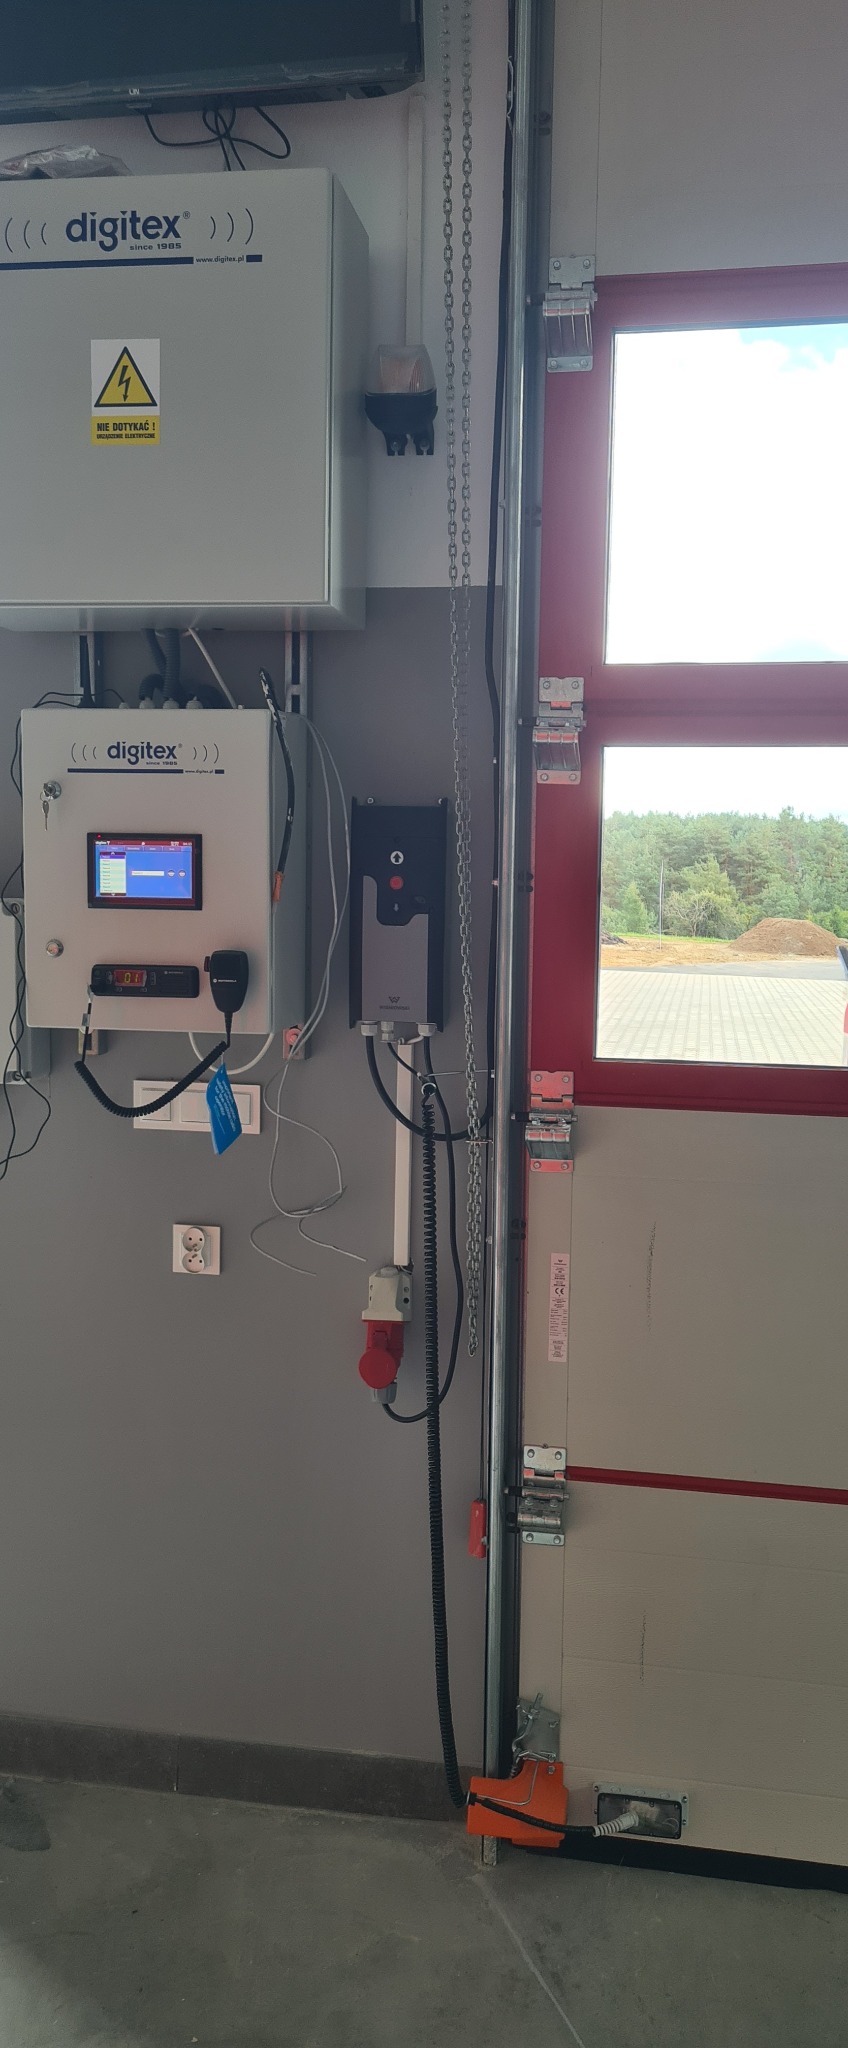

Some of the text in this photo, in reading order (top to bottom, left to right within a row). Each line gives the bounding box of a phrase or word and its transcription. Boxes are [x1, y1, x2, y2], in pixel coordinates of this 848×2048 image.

[156, 242, 182, 250] 1985
[195, 255, 245, 264] www.digitex.pl
[97, 422, 110, 431] NIE
[112, 419, 150, 431] DOTYKAĆ
[123, 972, 140, 983] 01
